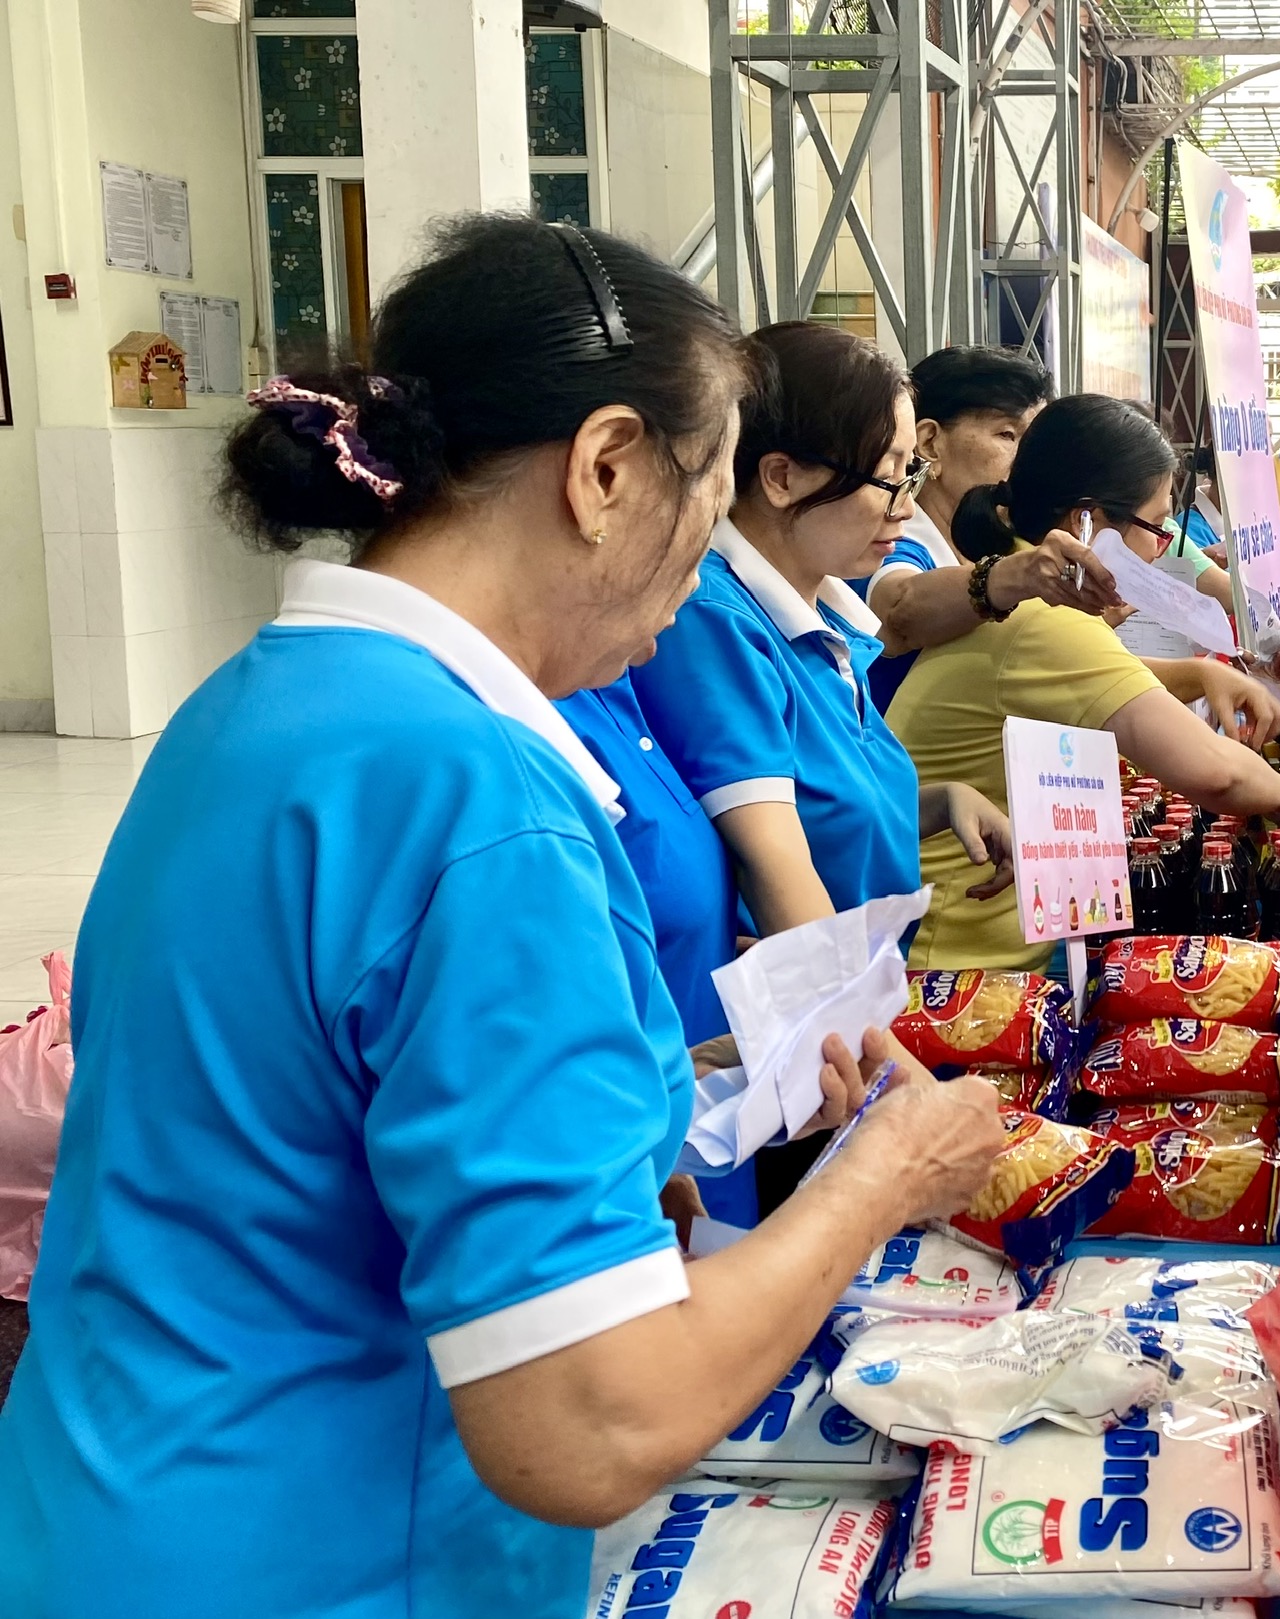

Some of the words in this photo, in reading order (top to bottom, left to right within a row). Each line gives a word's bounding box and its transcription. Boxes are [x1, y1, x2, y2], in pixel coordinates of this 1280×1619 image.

[1217, 393, 1241, 457] hàng
[1052, 802, 1073, 831] Gian
[1073, 802, 1098, 834] hàng
[946, 1453, 972, 1512] LONG
[827, 1510, 860, 1547] LONG
[1044, 1519, 1059, 1540] TTP
[818, 1548, 844, 1575] AN
[596, 1572, 622, 1619] REFIN
